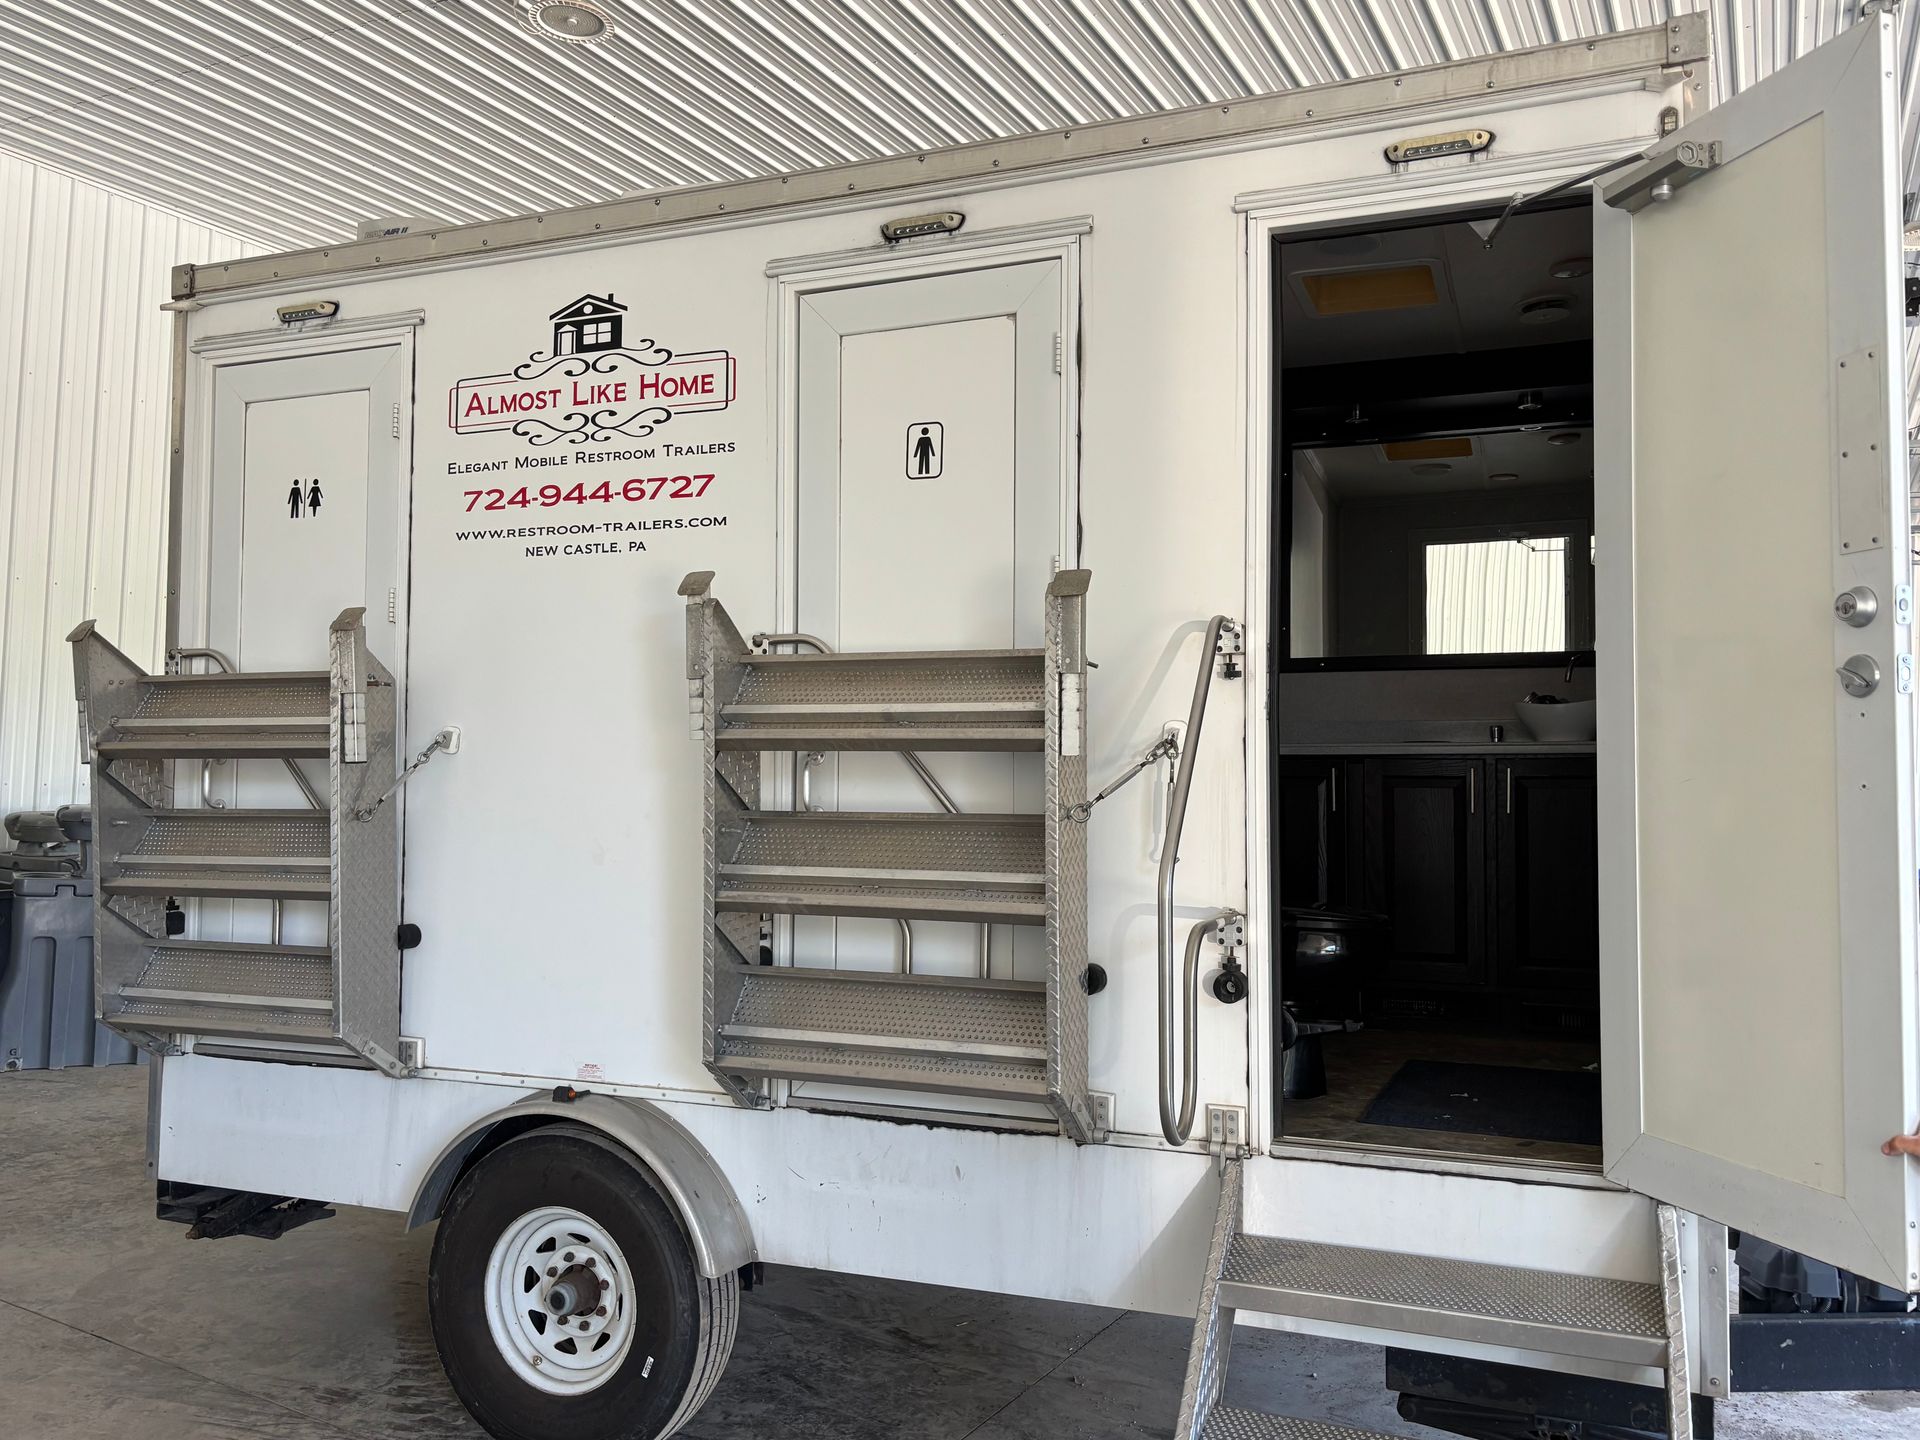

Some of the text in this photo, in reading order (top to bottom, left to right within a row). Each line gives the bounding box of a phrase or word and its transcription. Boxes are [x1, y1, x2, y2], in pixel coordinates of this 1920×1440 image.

[464, 372, 715, 418] ALMOST LIKE HOME
[447, 442, 736, 475] ELEGANT MOBILE RESTROOM TRAILERS
[463, 473, 716, 513] 724-944-6727
[456, 516, 728, 541] WWW.RESTROOM-TRAILERS.COM
[525, 541, 646, 558] NEW CASTLE, PA
